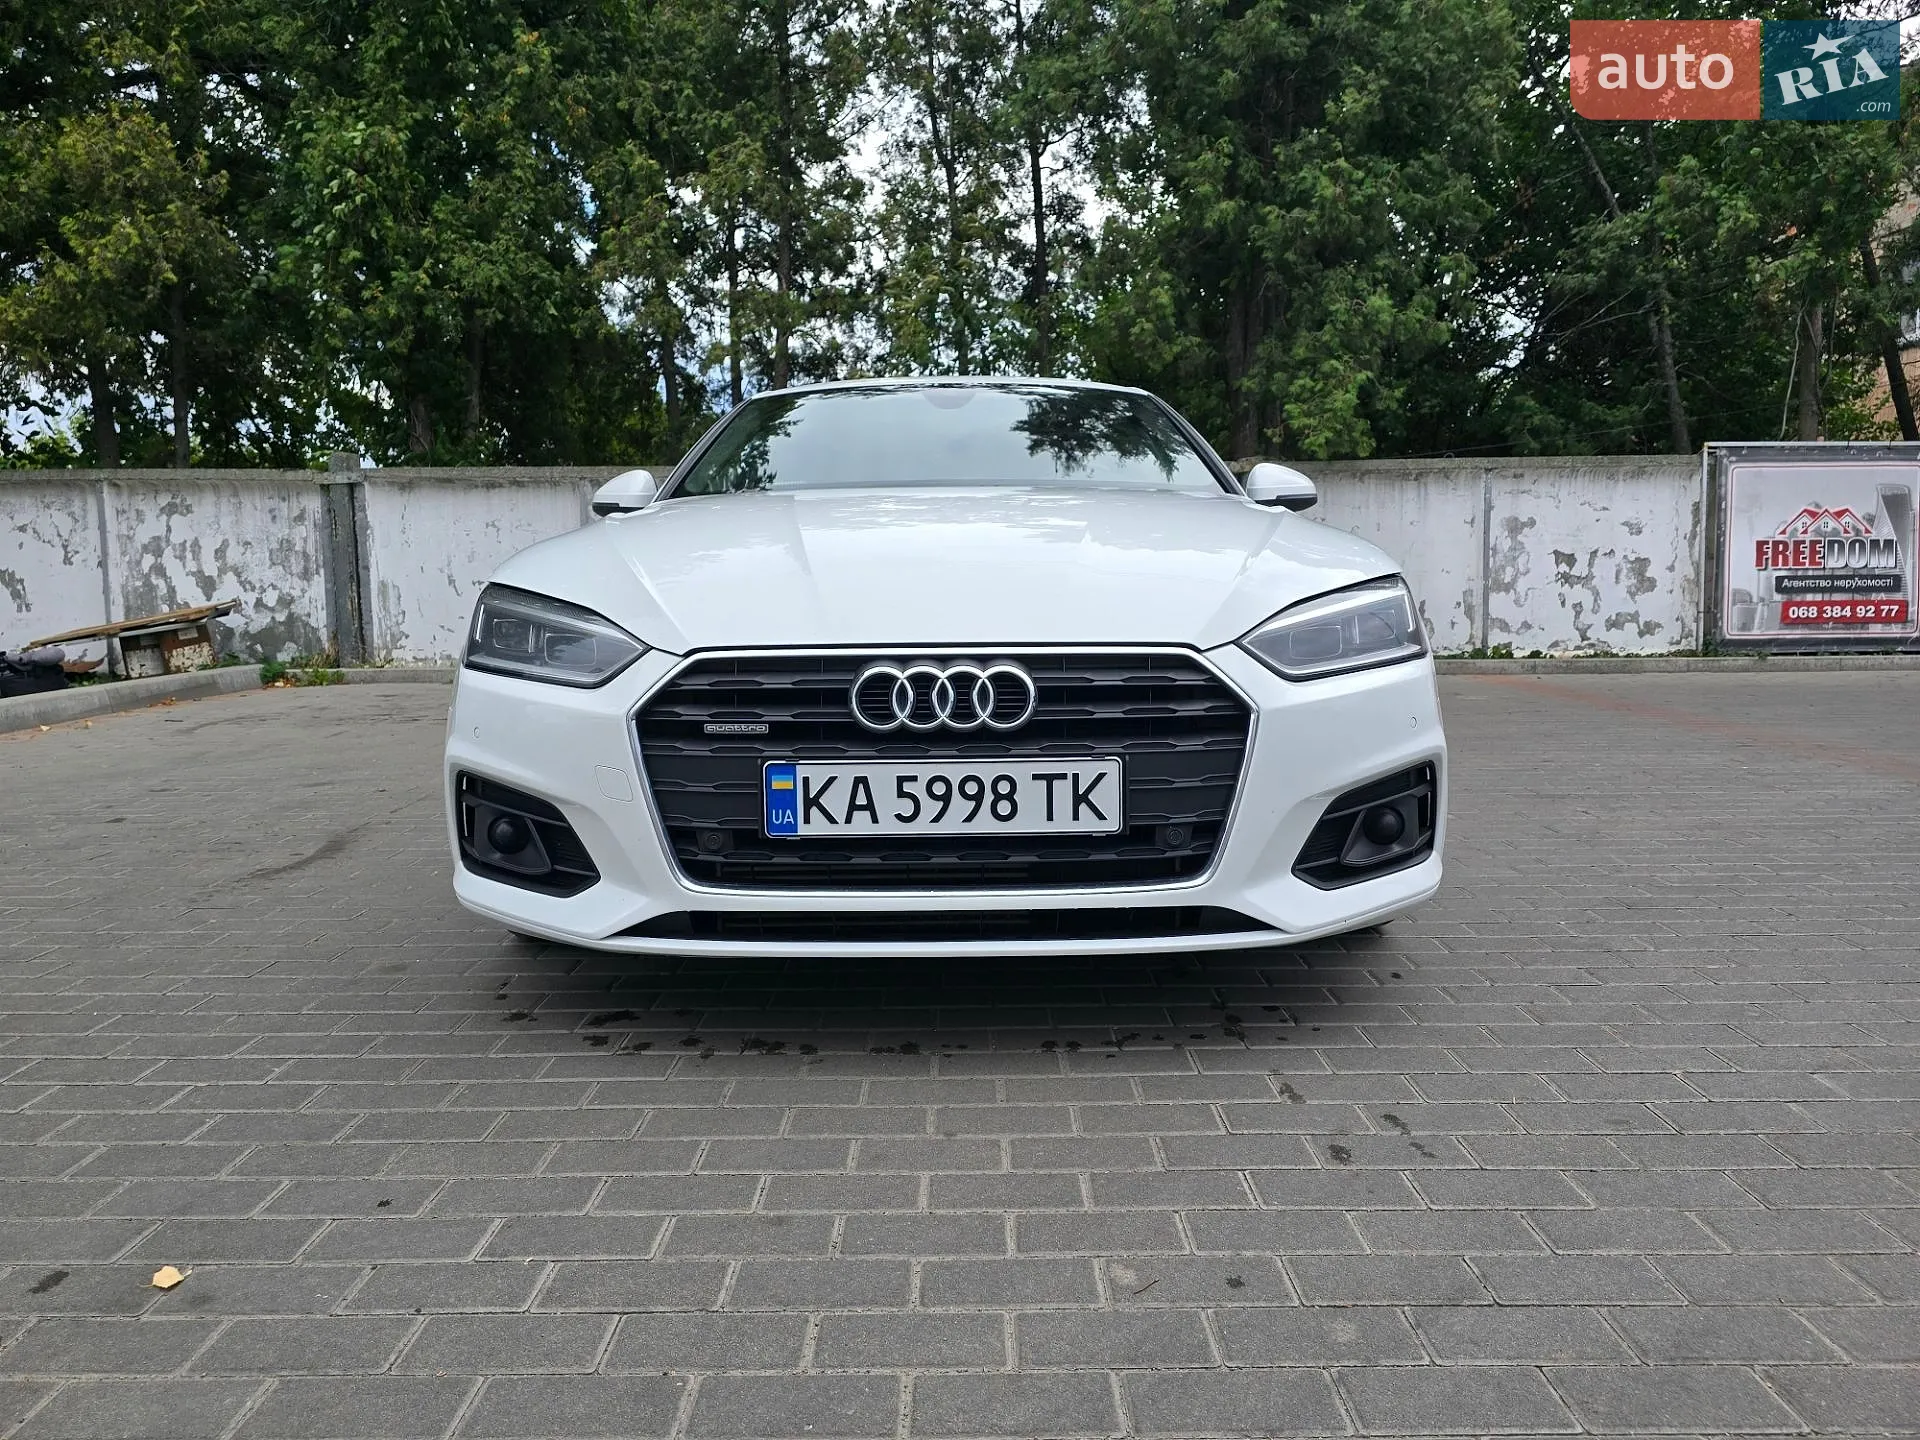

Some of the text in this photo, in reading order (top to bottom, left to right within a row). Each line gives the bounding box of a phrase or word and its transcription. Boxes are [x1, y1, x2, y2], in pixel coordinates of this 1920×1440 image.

[1755, 538, 1898, 569] FREEDOM
[1782, 578, 1832, 588] Агентство
[1788, 605, 1899, 618] 068 384 92 77
[706, 724, 766, 733] quattro
[802, 772, 1109, 825] KA 5998 TK
[772, 809, 794, 825] UA
